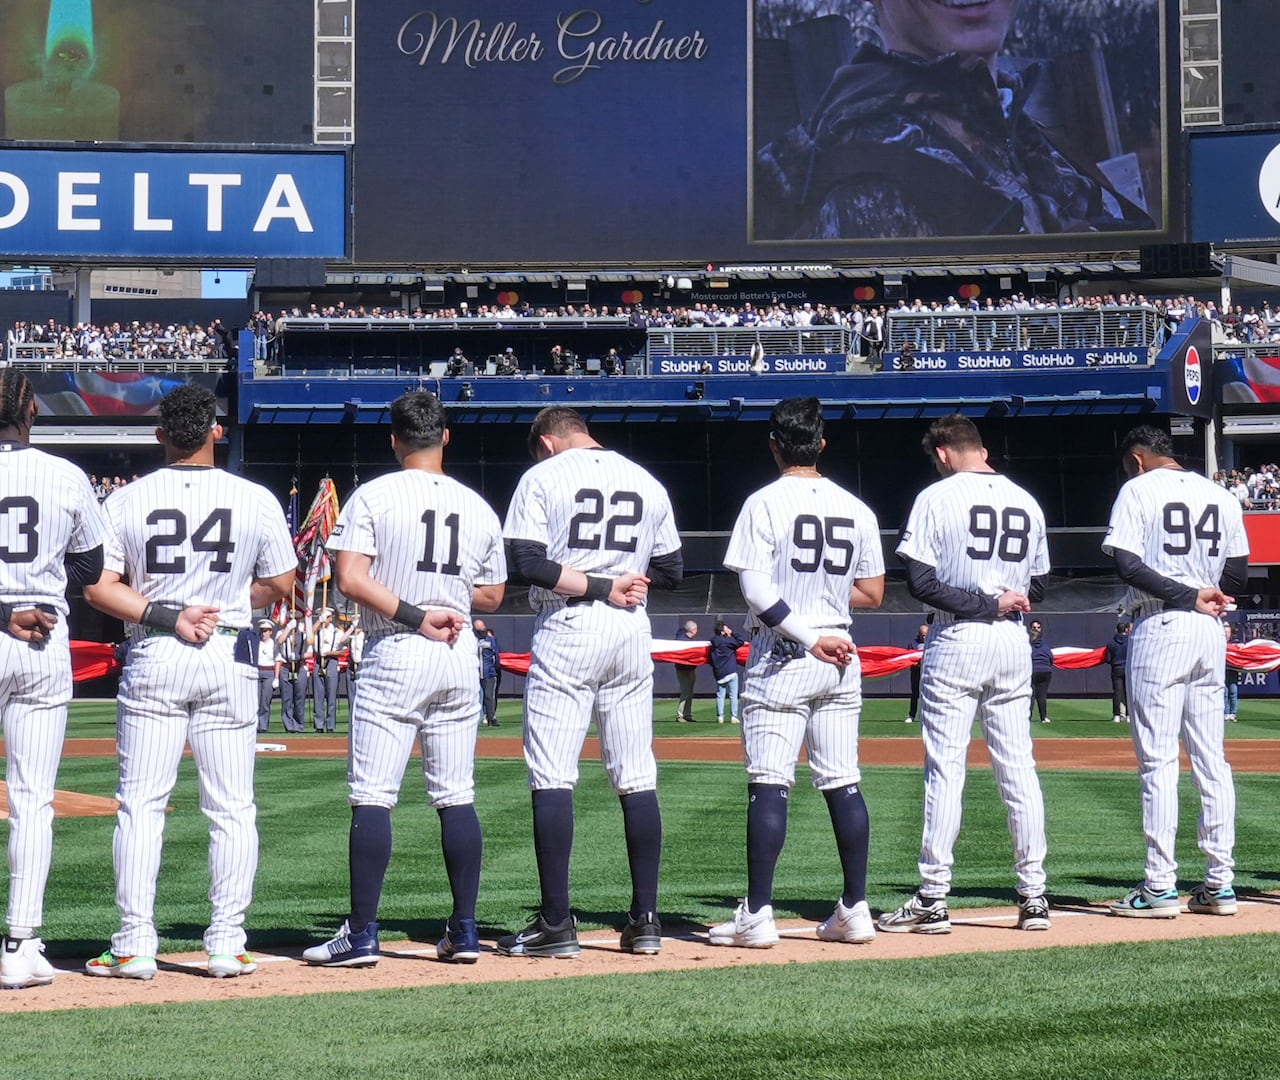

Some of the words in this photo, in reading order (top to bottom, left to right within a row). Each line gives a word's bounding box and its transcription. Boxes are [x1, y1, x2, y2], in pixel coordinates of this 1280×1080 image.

[396, 11, 543, 68] Miller
[552, 9, 708, 86] Gardner
[691, 292, 738, 301] Mastercard
[787, 291, 807, 299] Deck
[775, 359, 827, 371] StubHub
[892, 356, 947, 369] SbHub
[958, 355, 1011, 368] StubHub
[1022, 353, 1074, 366] StubHub
[1186, 368, 1199, 384] PEPSI
[146, 508, 235, 574] 24
[416, 508, 462, 576] 11
[568, 488, 643, 553] 22
[791, 514, 855, 576] 95
[966, 504, 1031, 563] 98
[1163, 502, 1222, 557] 94
